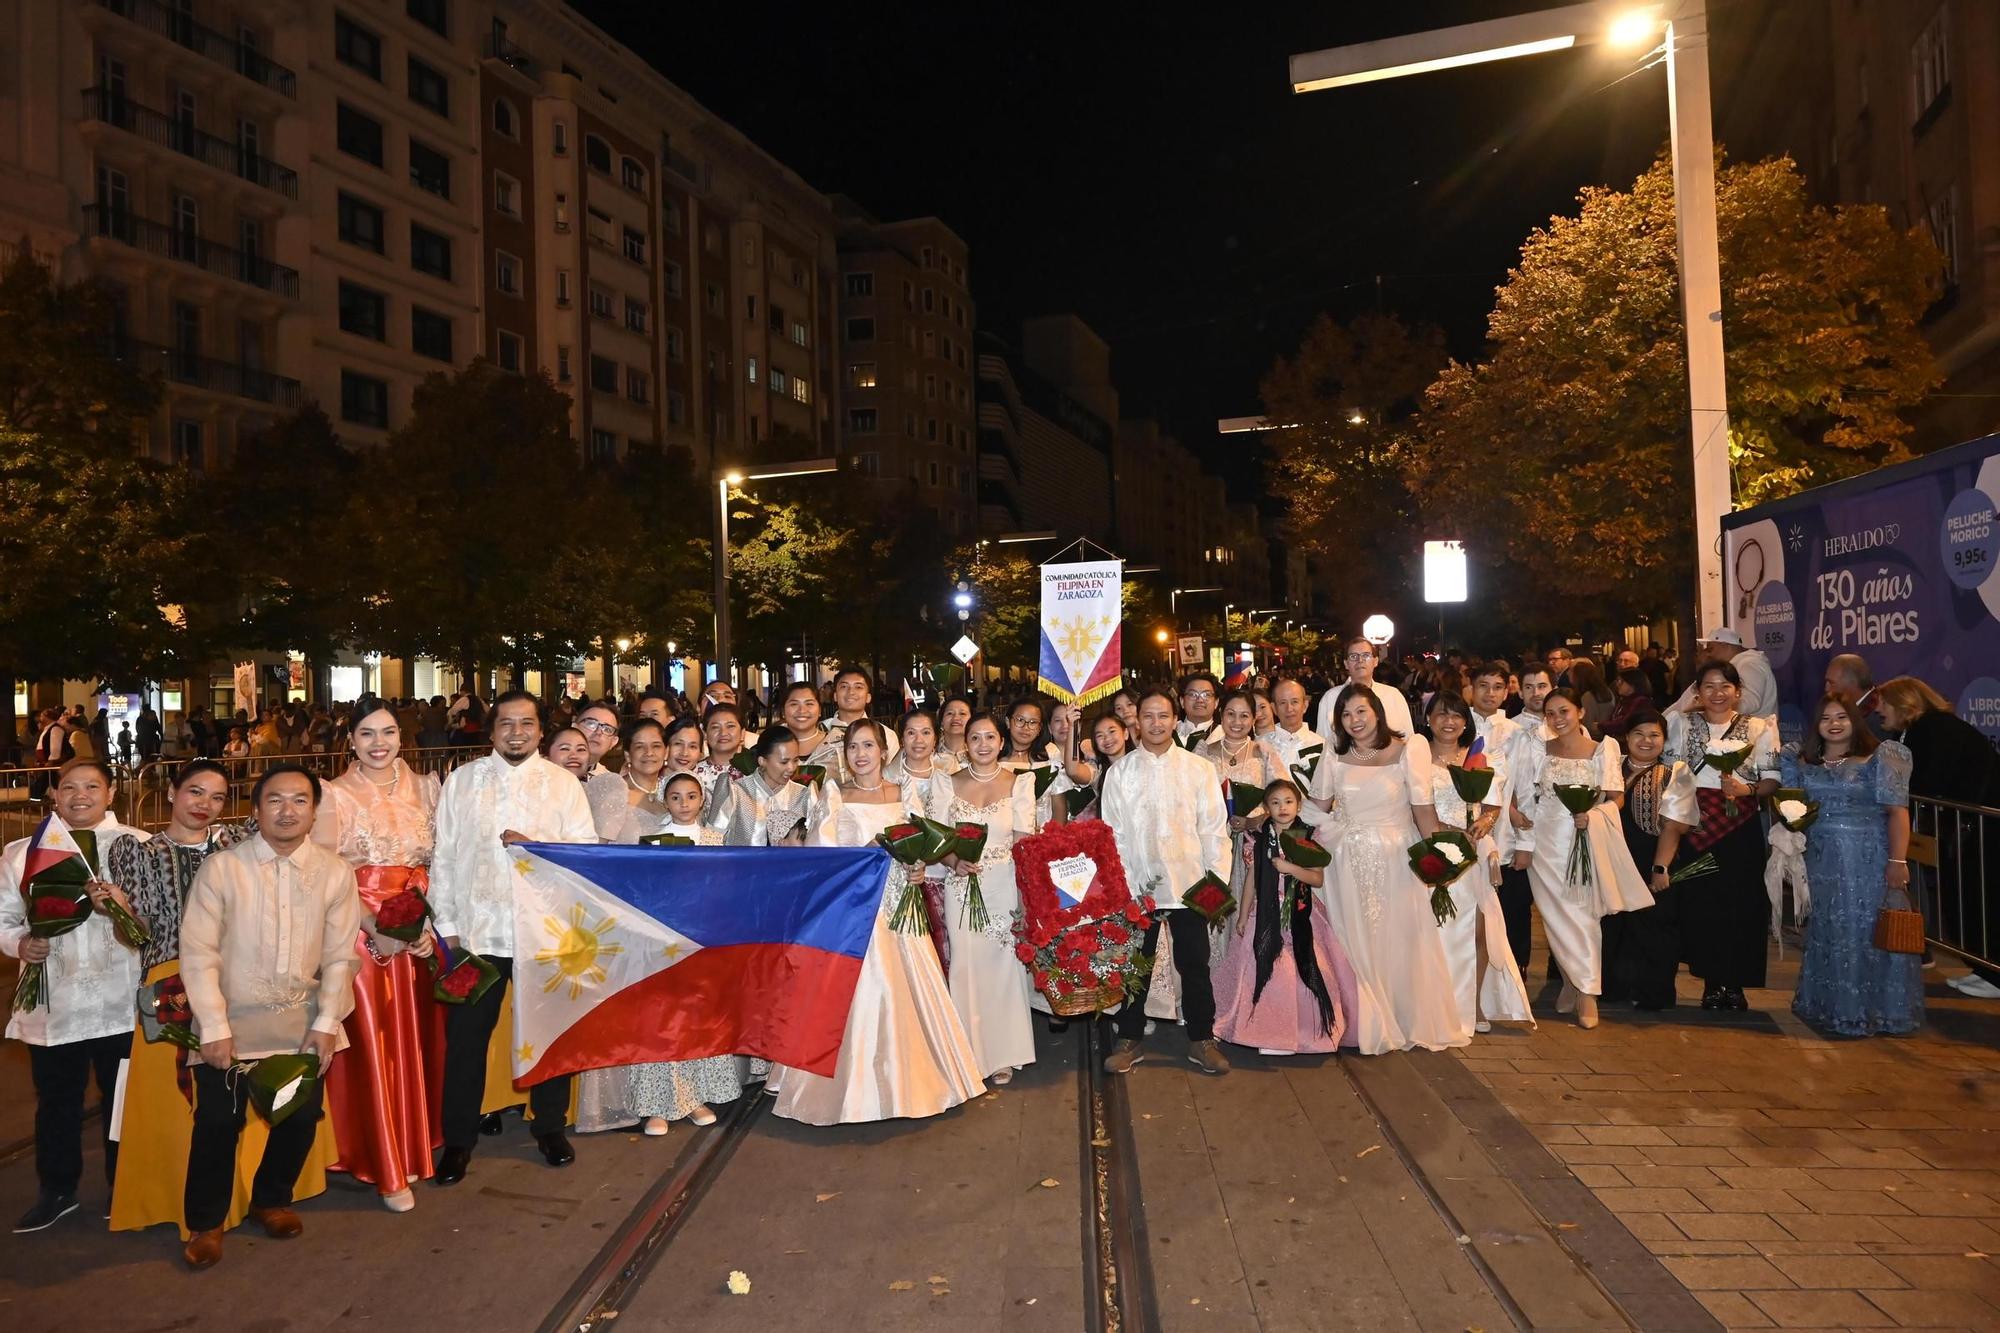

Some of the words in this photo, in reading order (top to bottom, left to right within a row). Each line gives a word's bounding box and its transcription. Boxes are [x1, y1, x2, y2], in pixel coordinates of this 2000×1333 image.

[1947, 510, 1992, 531] PELUCHE
[1825, 528, 1883, 557] HERALDO
[1950, 525, 1990, 544] MORICO
[1045, 573, 1083, 581] COMUNIDAD
[1057, 581, 1090, 590] FILIPINA
[1092, 580, 1103, 588] EN
[1058, 590, 1103, 600] ZARAGOZA
[1817, 569, 1855, 610] 130
[1862, 567, 1913, 605] años
[1756, 610, 1793, 625] ANIVERSARIO
[1810, 610, 1834, 651] de
[1841, 605, 1920, 647] Pilares
